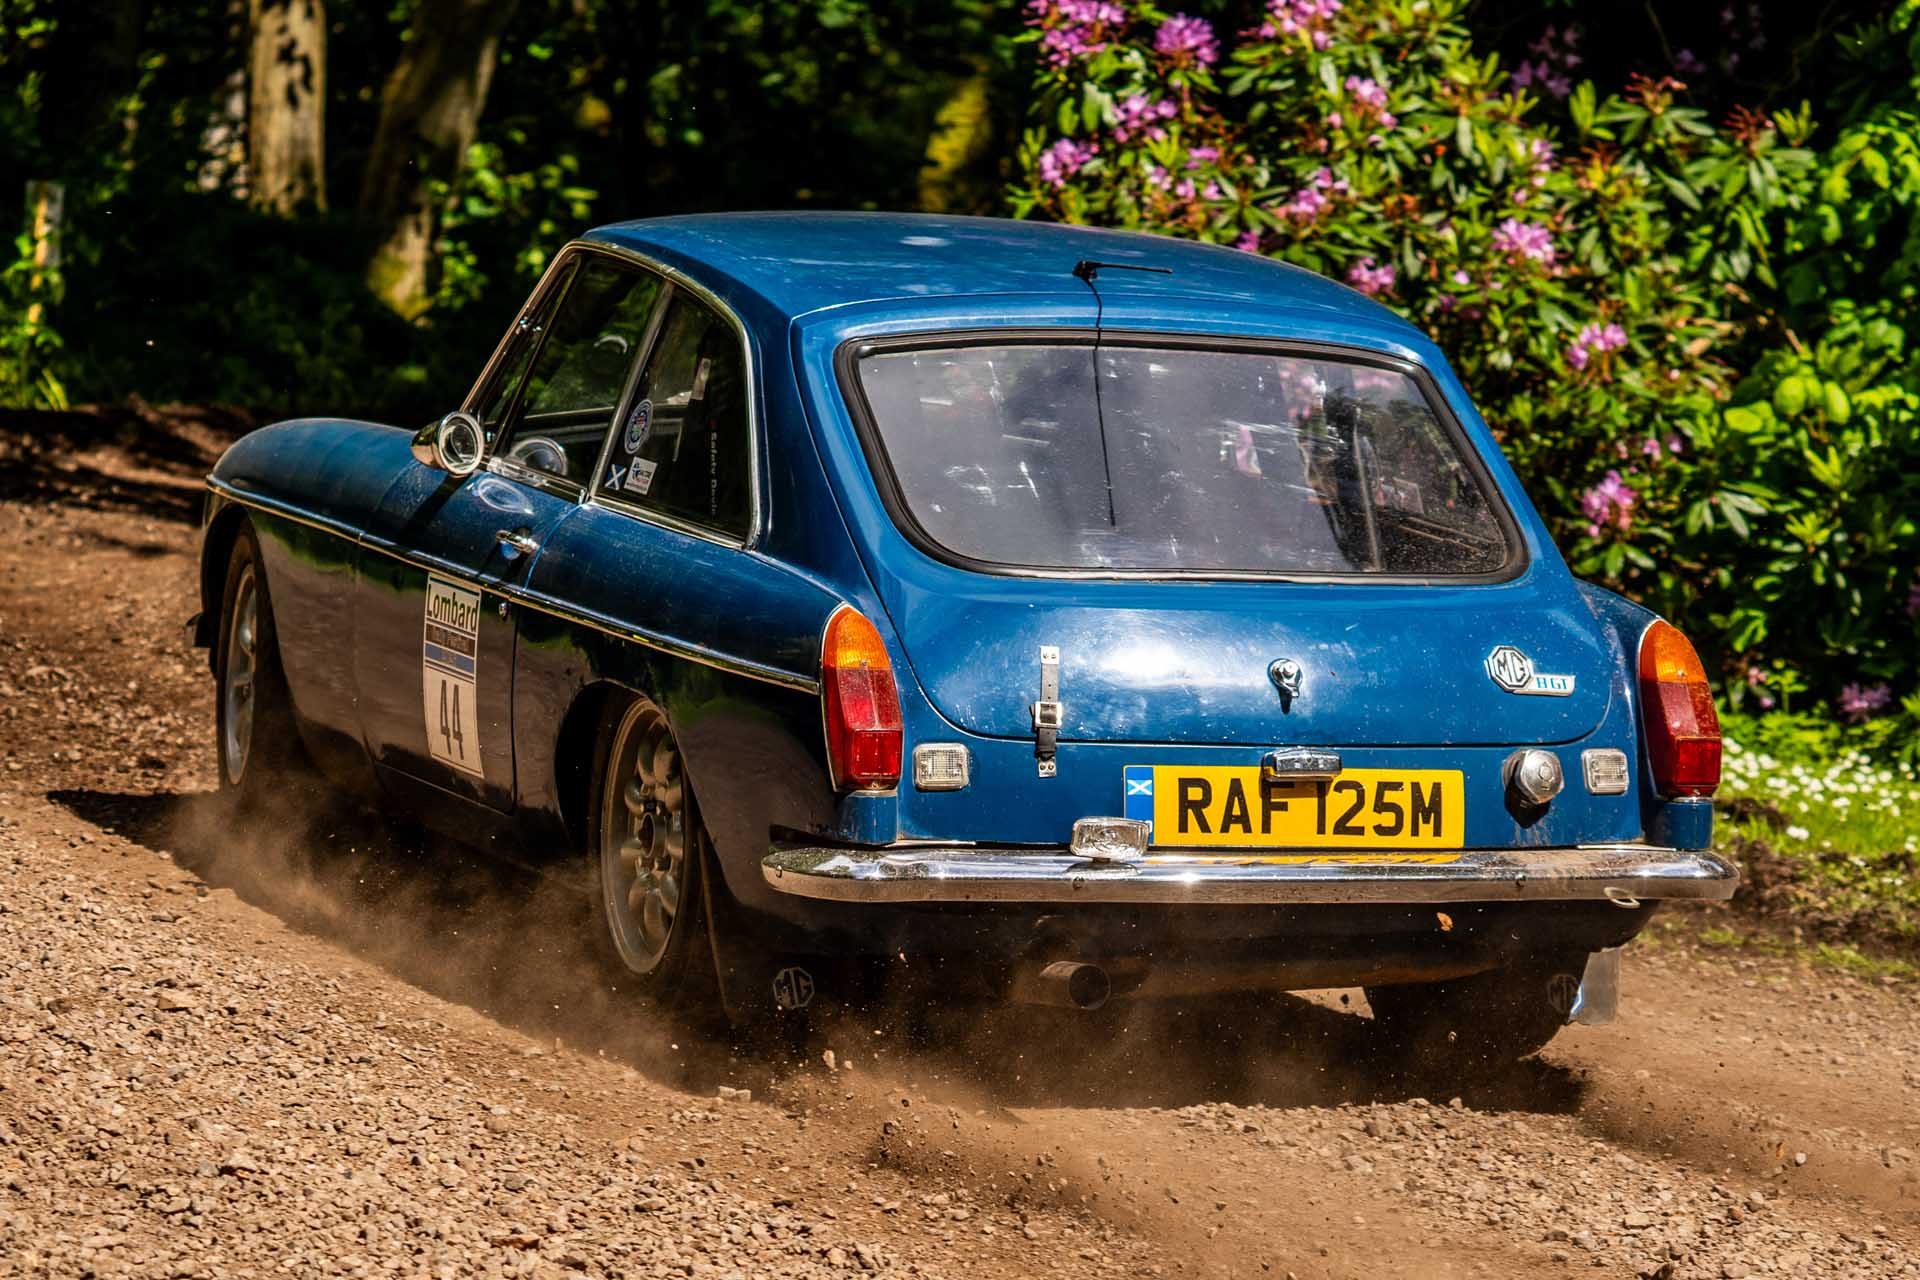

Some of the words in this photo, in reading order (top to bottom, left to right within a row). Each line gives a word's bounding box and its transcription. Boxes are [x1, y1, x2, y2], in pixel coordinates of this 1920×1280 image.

[427, 583, 480, 632] Lombard
[1491, 648, 1529, 686] MG
[440, 679, 464, 760] 44
[1177, 777, 1295, 835] RAF
[1316, 779, 1442, 838] 125M
